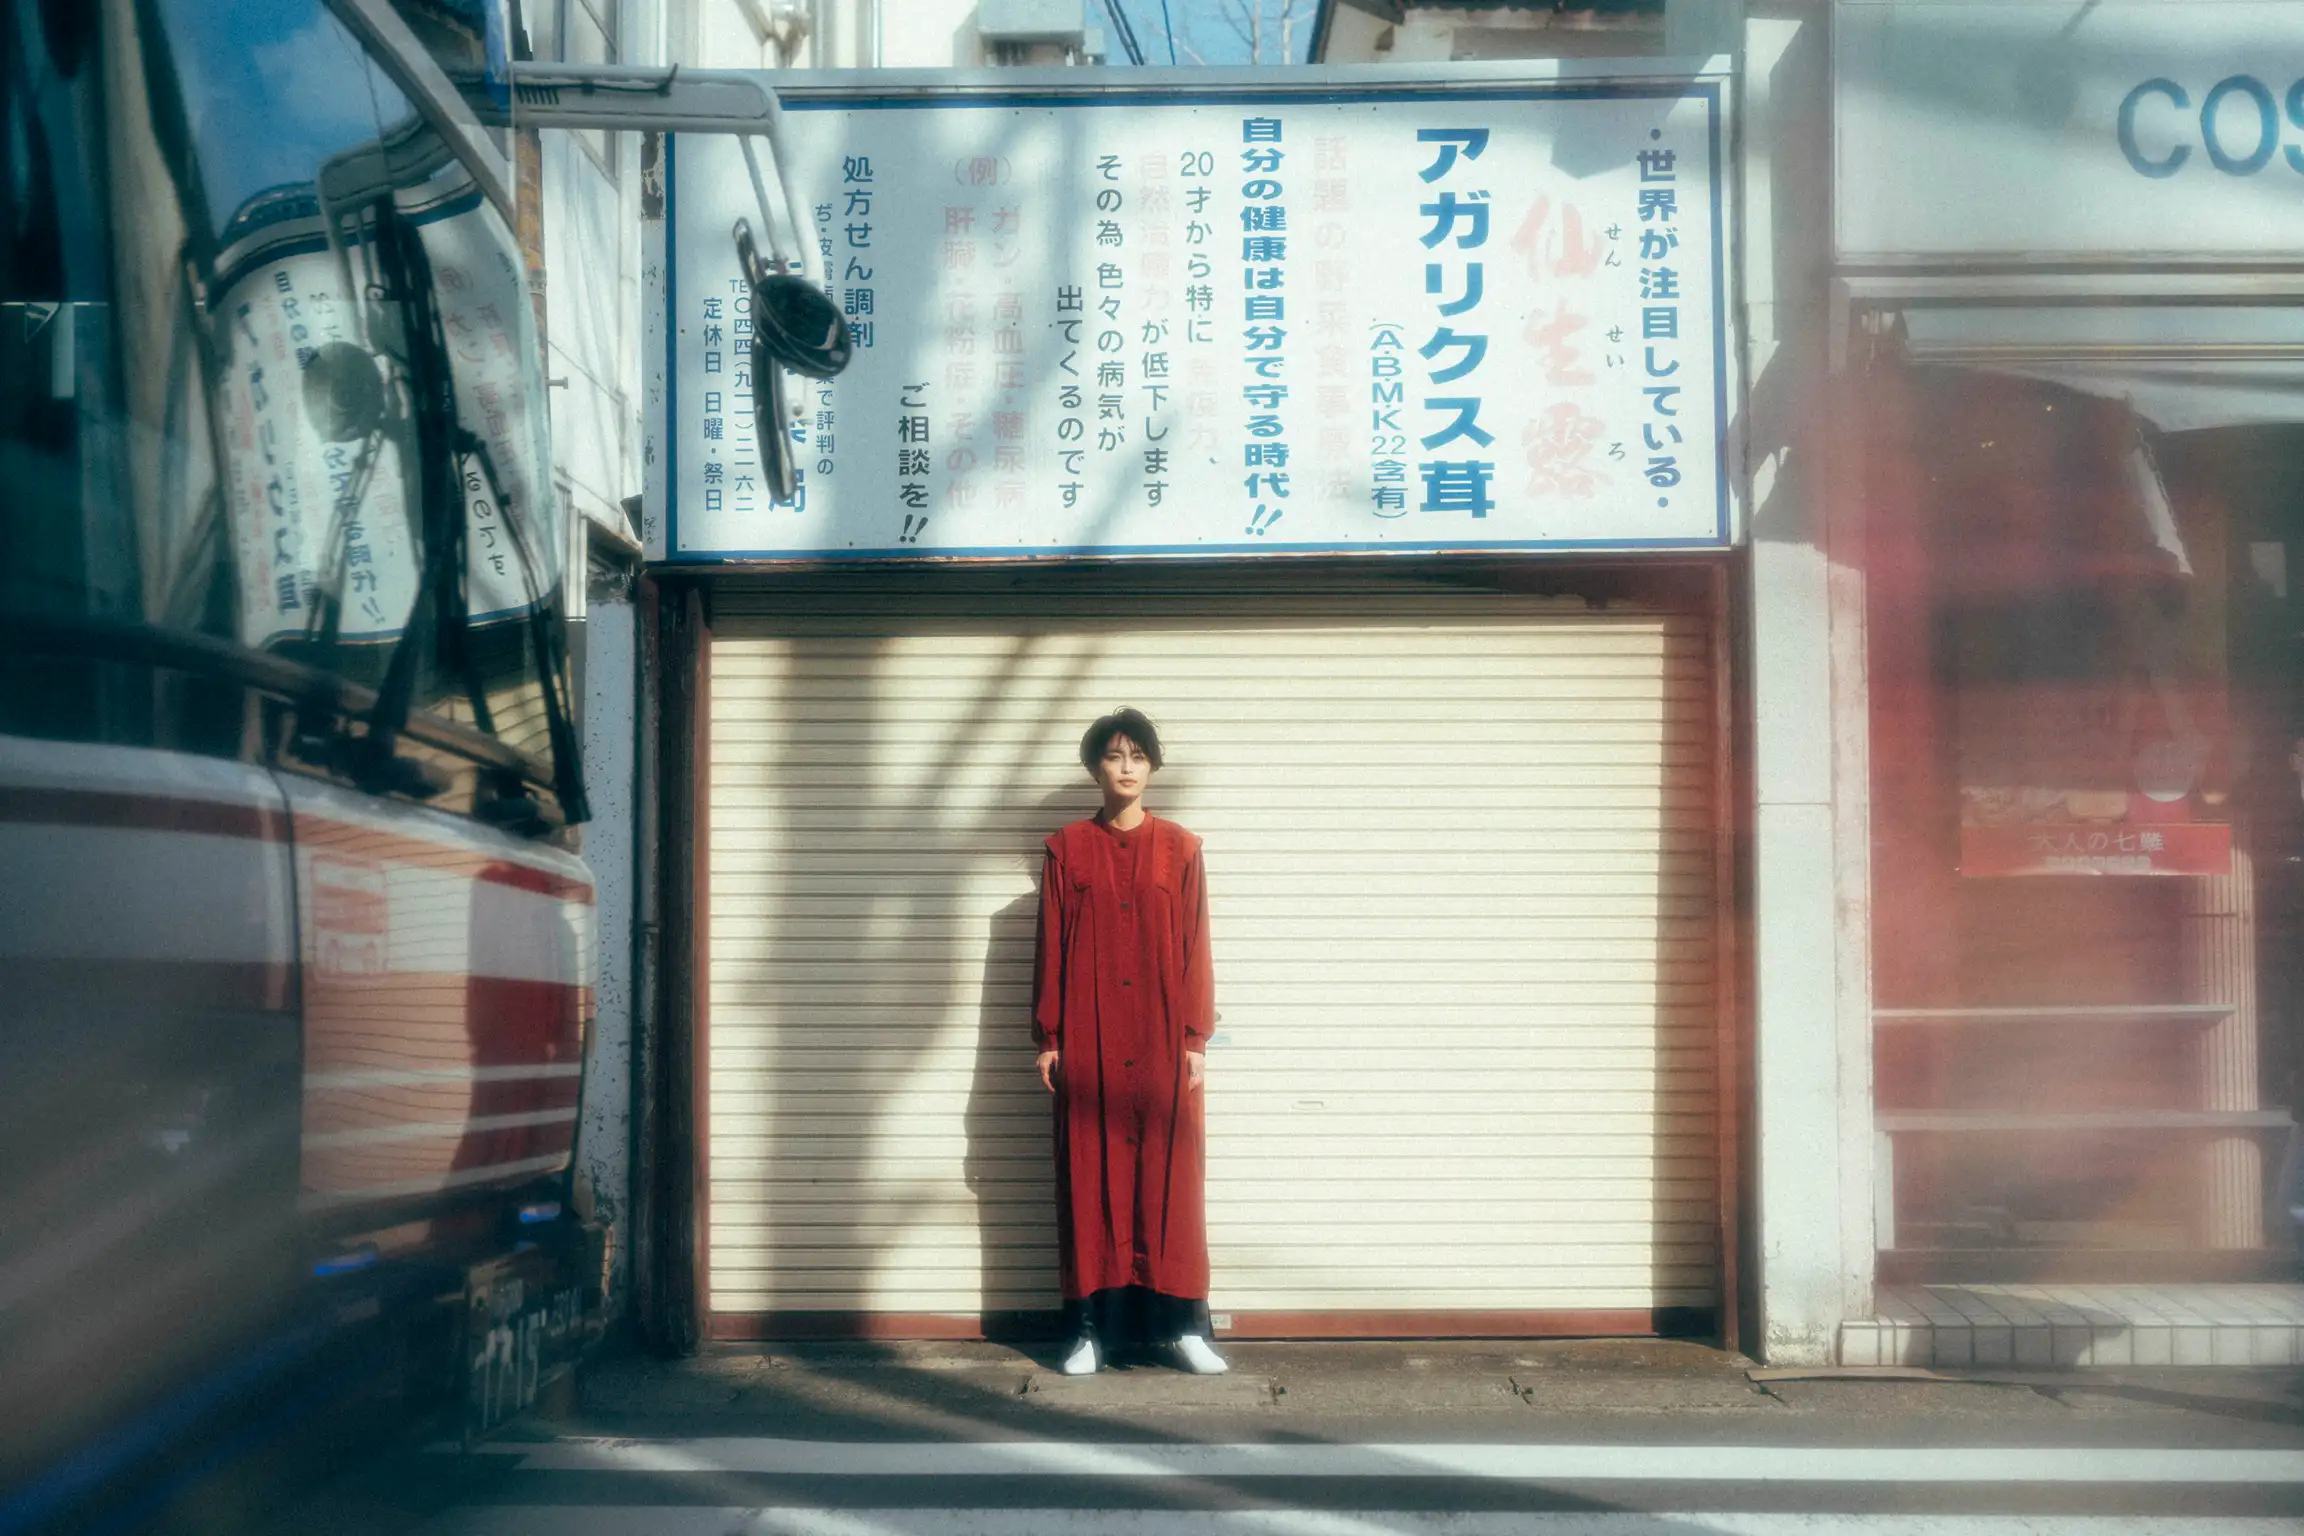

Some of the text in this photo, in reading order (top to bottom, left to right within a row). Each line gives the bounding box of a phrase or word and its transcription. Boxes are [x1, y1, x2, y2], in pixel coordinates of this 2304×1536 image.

[843, 155, 875, 348] 処方せん調剤
[1416, 127, 1496, 519] アガリクス茸
[898, 381, 931, 544] ご相談を!!
[1056, 284, 1085, 509] 出てくるのです
